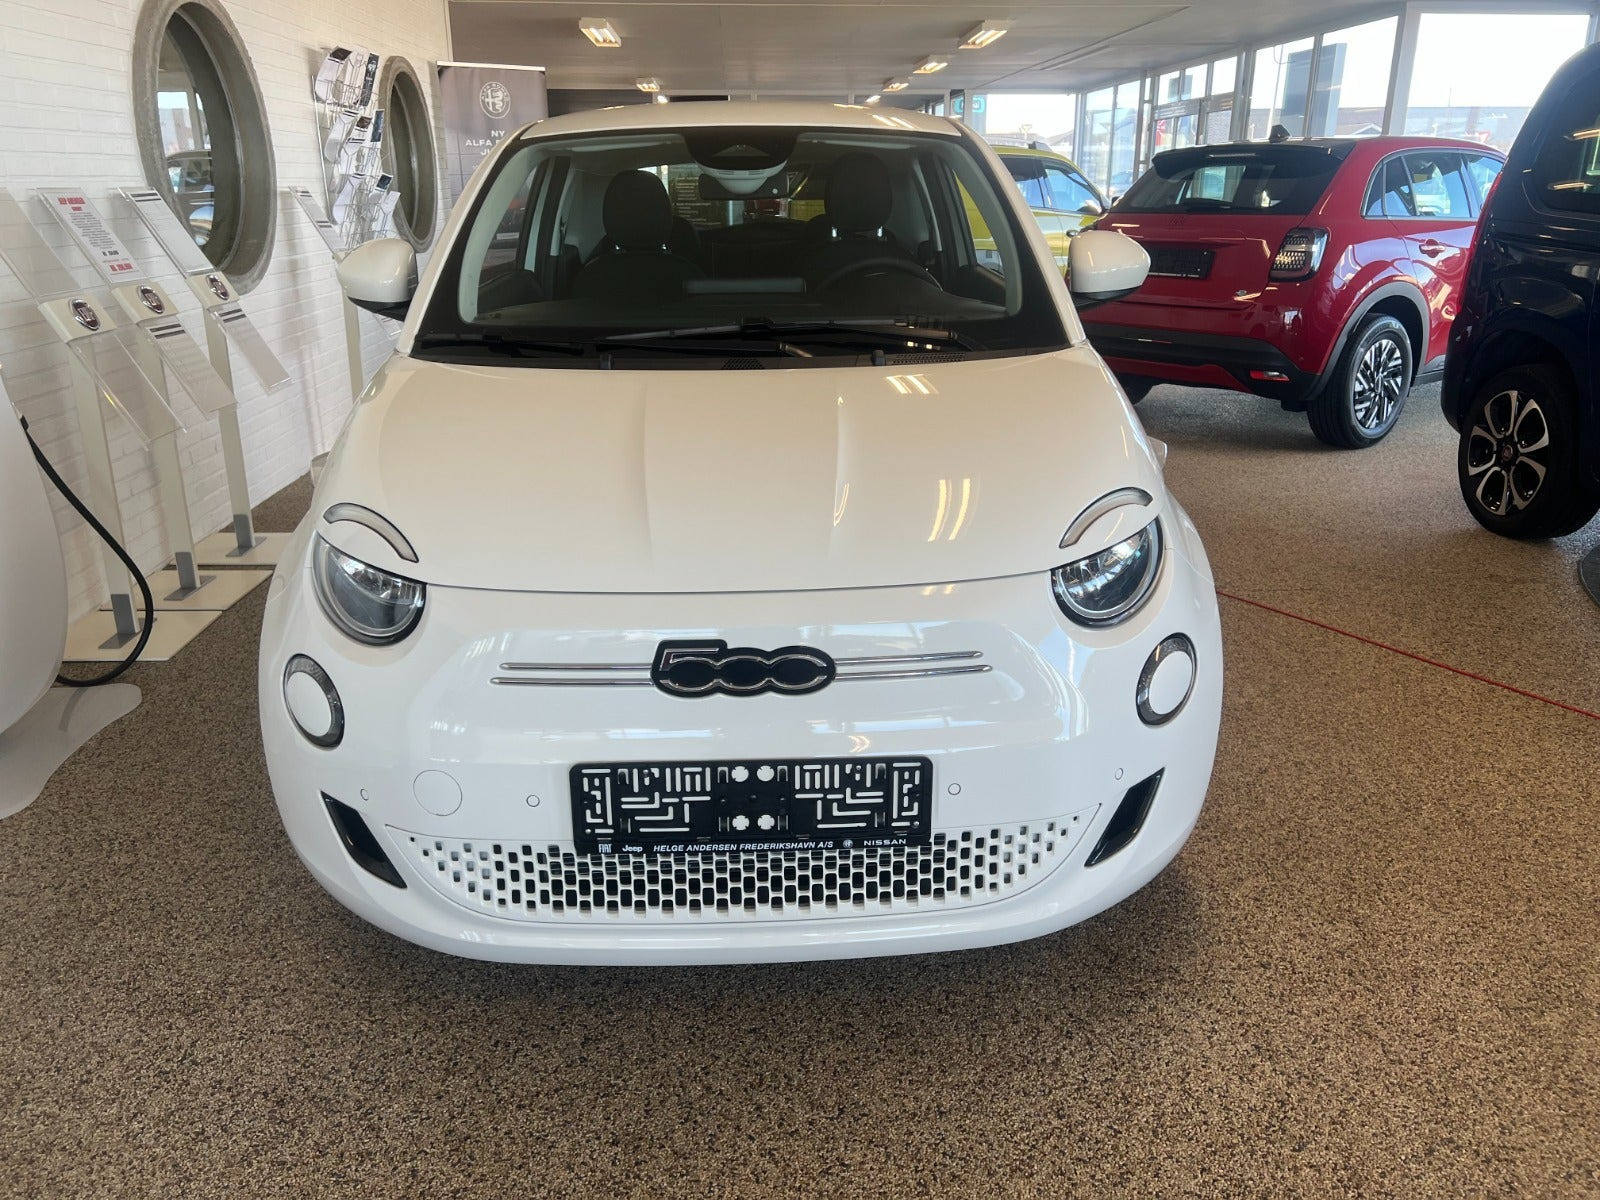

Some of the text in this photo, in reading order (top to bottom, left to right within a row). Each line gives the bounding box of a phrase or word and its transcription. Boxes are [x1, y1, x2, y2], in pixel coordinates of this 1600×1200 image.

[465, 139, 493, 147] ALFA
[654, 643, 834, 696] 500
[598, 838, 907, 854] FIAT Jeep HELGE ANDERSEN FREDERIKSHAVN A/S NISSAN
